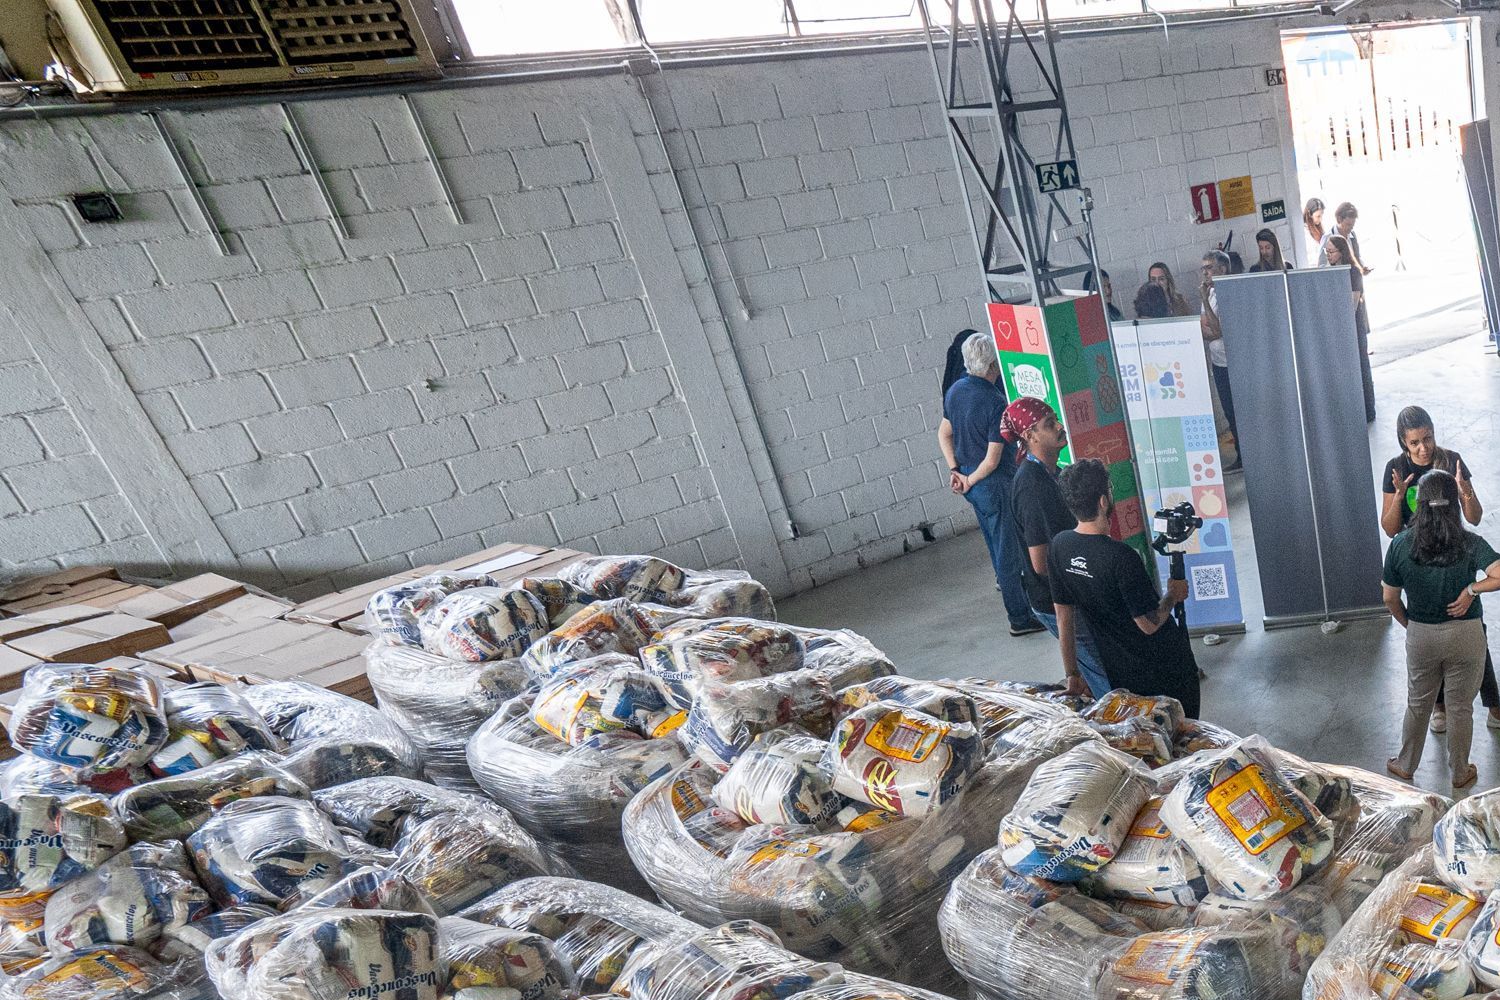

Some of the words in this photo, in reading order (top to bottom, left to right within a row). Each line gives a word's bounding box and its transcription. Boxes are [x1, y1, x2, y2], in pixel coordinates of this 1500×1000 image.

[1263, 206, 1284, 218] SAÍDA
[1016, 370, 1042, 383] MESA
[1017, 382, 1045, 396] BRASIL
[61, 719, 143, 751] Vasconcelos
[1036, 835, 1092, 882] Vasconcelos
[347, 970, 437, 1000] Vasconcelos
